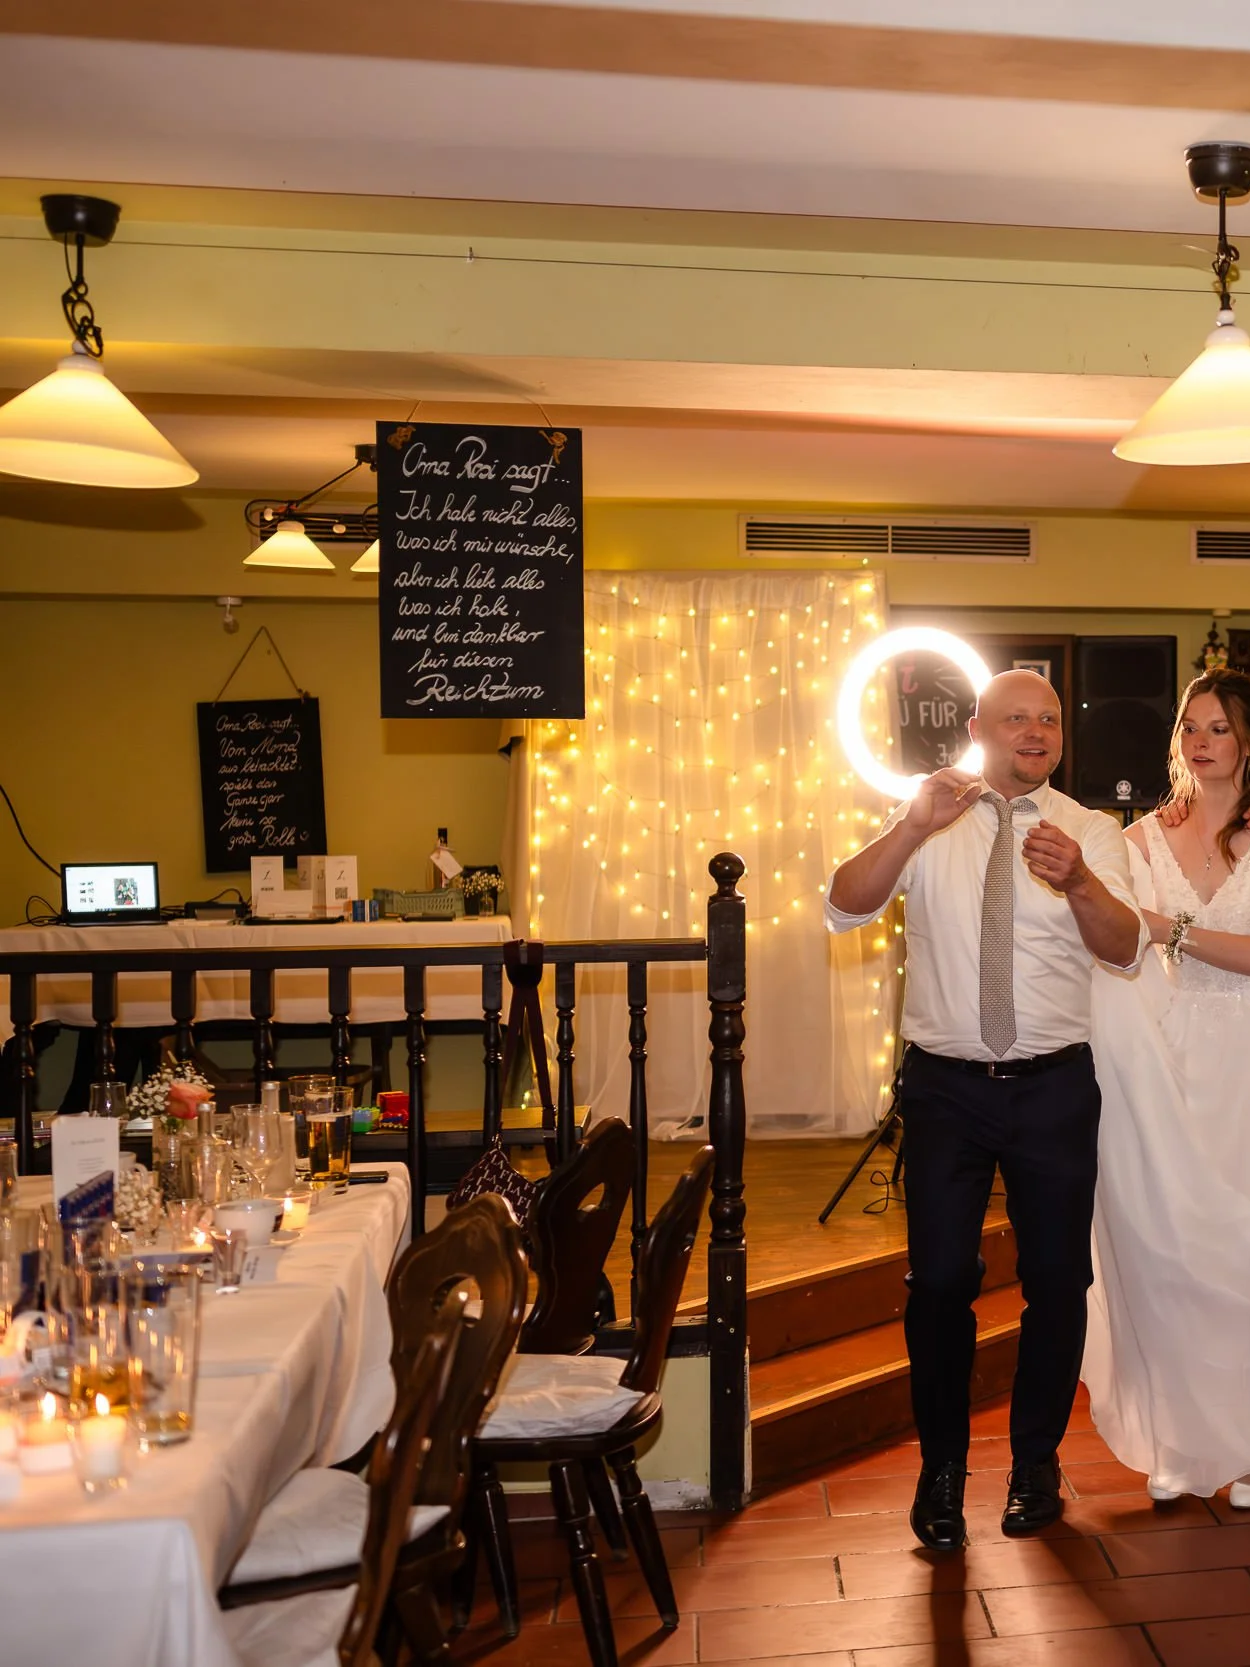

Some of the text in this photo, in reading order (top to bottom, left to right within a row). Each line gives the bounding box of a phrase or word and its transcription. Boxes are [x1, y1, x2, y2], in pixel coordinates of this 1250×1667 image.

[402, 442, 450, 477] Oma
[456, 435, 498, 481] Rosi
[395, 490, 579, 534] Ich habe nicht alles,
[432, 529, 457, 552] ich
[463, 534, 493, 552] mir
[494, 532, 575, 564] wünsche,
[394, 561, 545, 590] aber ich liebe alles
[434, 596, 461, 617] ich
[392, 622, 546, 645] und bin dankbar
[407, 648, 514, 673] für diesen
[406, 671, 545, 706] Reichtum
[216, 714, 240, 732] Oma
[919, 696, 957, 728] FÜR
[251, 730, 301, 755] Mond
[258, 824, 296, 849] Rolle
